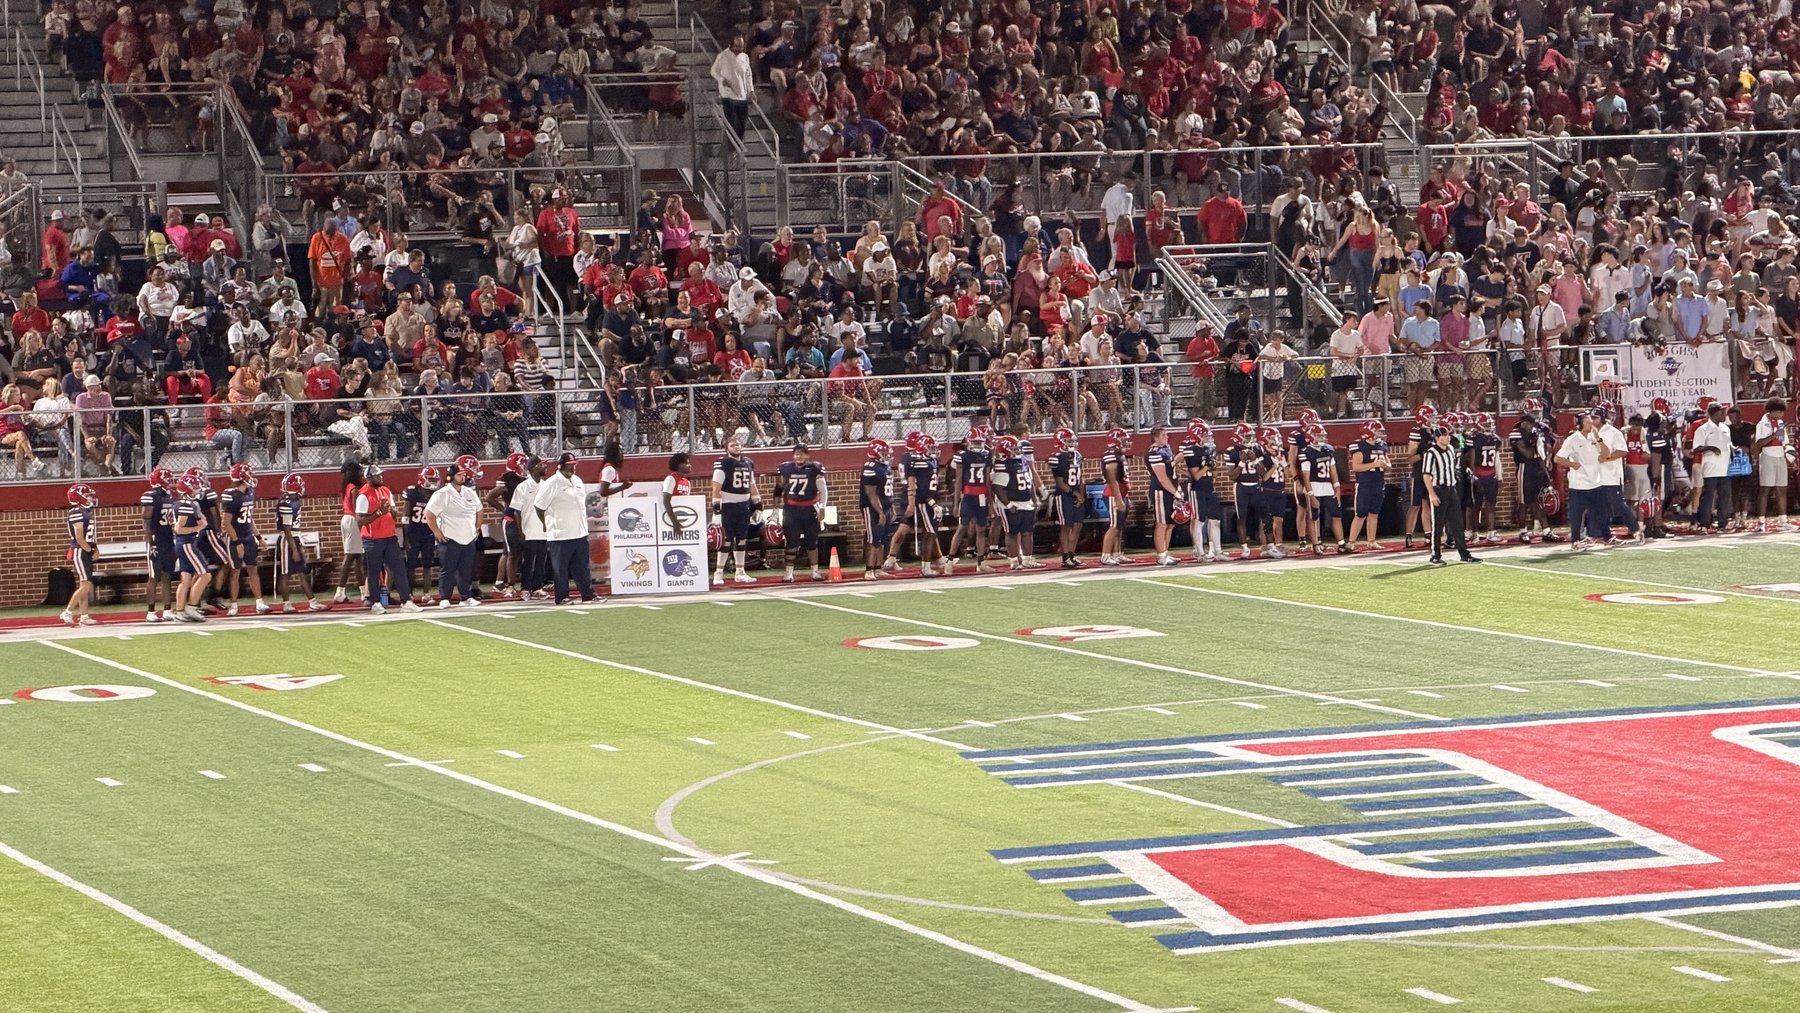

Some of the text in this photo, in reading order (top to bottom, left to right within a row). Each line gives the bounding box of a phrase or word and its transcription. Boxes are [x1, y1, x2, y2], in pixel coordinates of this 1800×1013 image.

[1671, 346, 1699, 359] GHSA
[1632, 378, 1718, 388] TUDENT SECTION
[1643, 388, 1707, 398] OF THE YEAR
[1481, 449, 1496, 467] 13
[968, 467, 984, 483] 14
[1316, 461, 1331, 478] 31
[732, 471, 750, 489] 65
[788, 478, 809, 495] 77
[1016, 472, 1033, 490] 59
